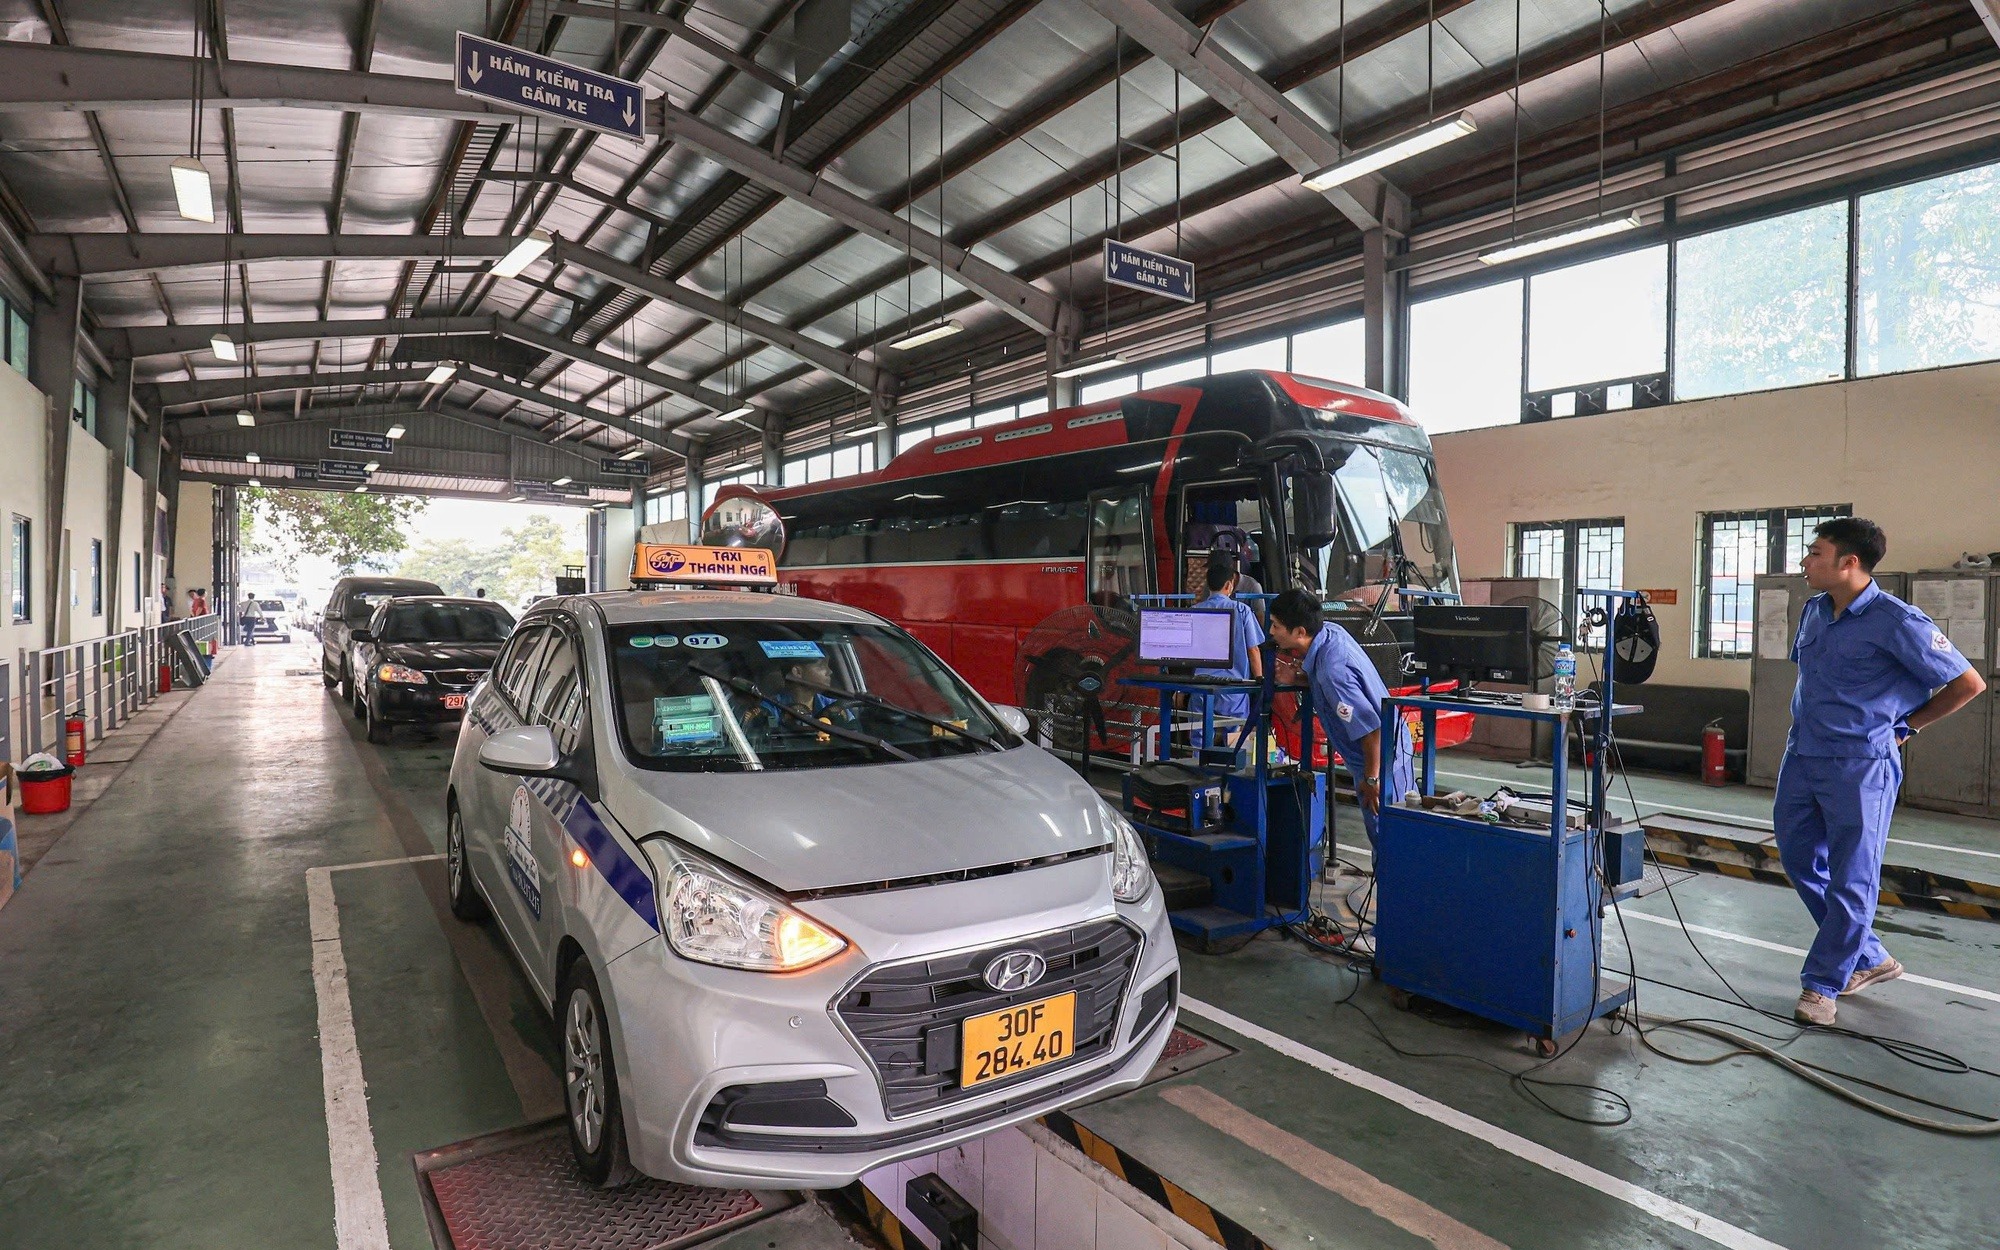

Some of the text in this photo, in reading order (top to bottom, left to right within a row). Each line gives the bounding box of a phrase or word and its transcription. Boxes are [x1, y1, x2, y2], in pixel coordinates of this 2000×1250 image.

[489, 55, 615, 103] HẦM KIỂM TRA
[521, 85, 587, 115] GẦM XE
[1165, 265, 1180, 277] TRA
[1157, 277, 1168, 288] XE
[712, 551, 742, 562] TAXI
[689, 562, 767, 575] THANH NGA
[689, 636, 721, 646] 971
[997, 1003, 1045, 1042] 30F
[975, 1030, 1063, 1081] 284.40
